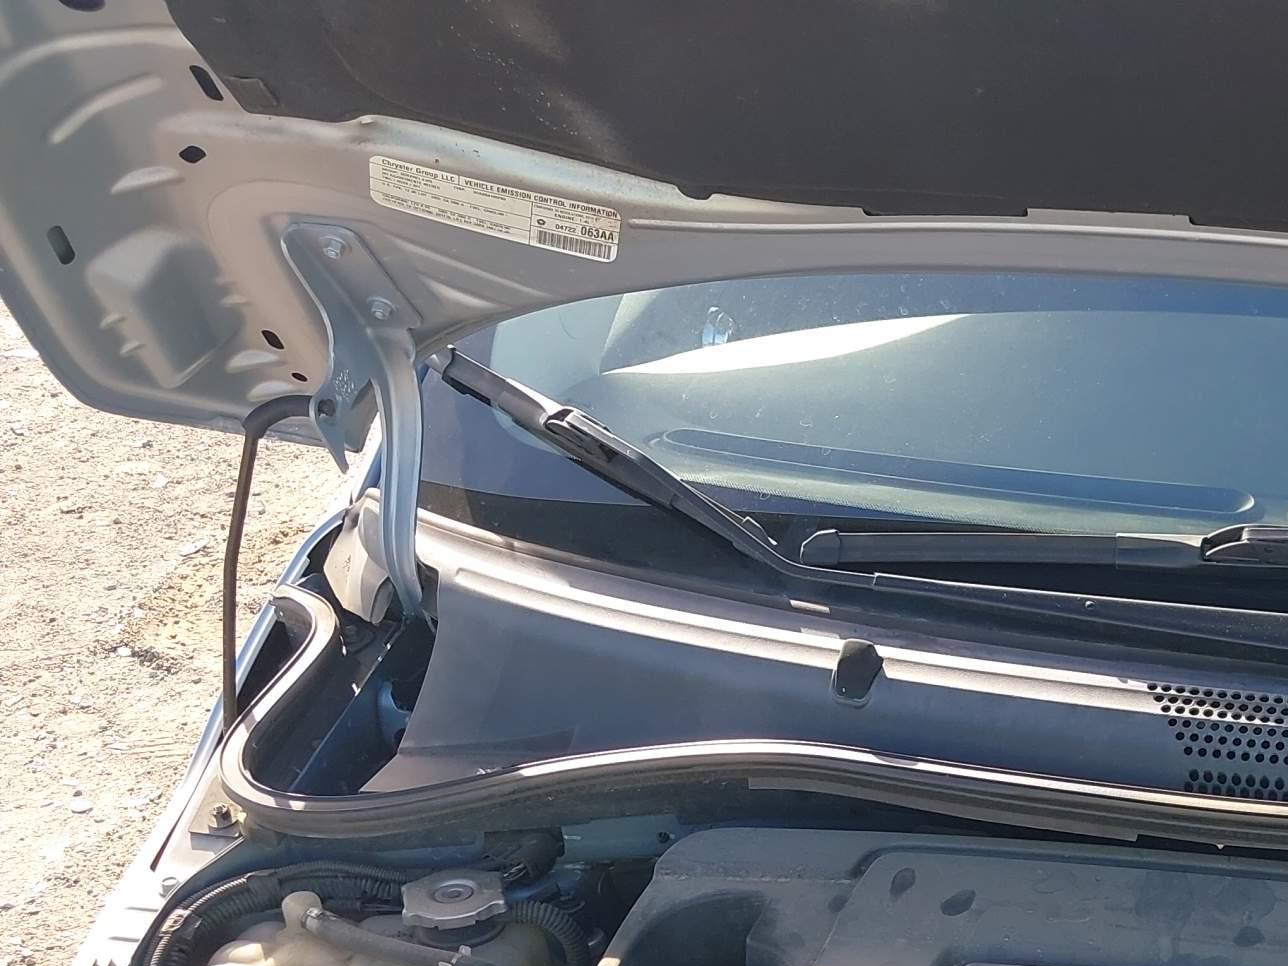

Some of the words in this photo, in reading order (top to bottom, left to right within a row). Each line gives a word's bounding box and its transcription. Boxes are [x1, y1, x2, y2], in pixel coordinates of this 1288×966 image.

[382, 159, 413, 172] Chrysler
[416, 166, 438, 179] Group
[464, 179, 493, 191] VEHICLE
[497, 186, 532, 200] EMISSION
[533, 195, 567, 208] CONTROL
[569, 203, 618, 218] INFORMATION
[555, 223, 576, 233] 04722
[581, 226, 615, 242] 063AA
